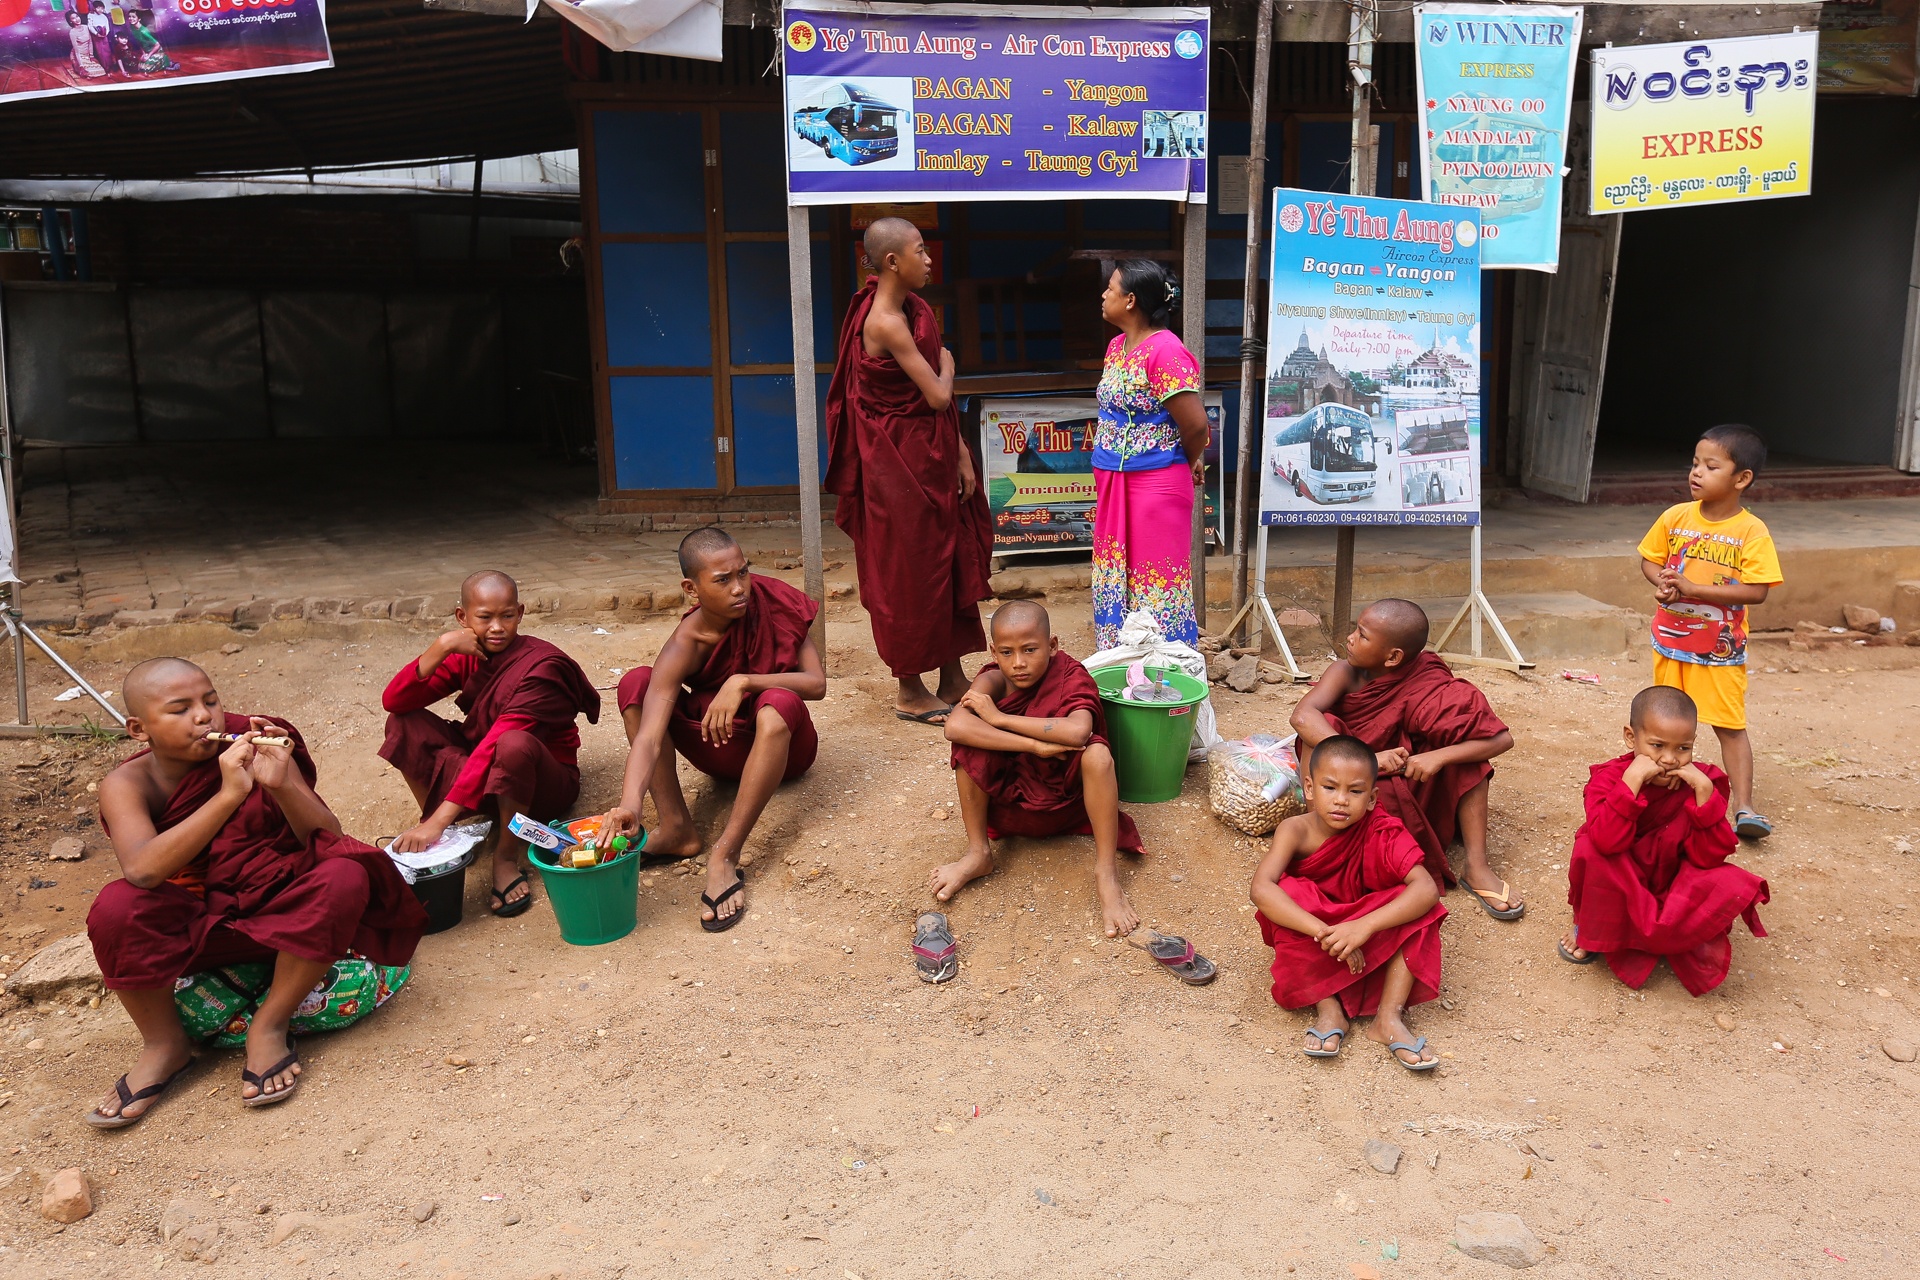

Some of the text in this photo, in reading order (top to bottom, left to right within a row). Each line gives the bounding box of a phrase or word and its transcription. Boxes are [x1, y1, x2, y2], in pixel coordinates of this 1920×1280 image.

[1455, 22, 1565, 47] WINNER
[861, 30, 909, 53] Thu
[914, 31, 976, 60] Aung
[1002, 34, 1038, 56] Air
[1043, 35, 1086, 57] Con
[1089, 35, 1171, 62] Express
[1460, 62, 1534, 78] EXPRESS
[914, 77, 1011, 100] BAGAN
[1065, 79, 1148, 103] Yangon
[1447, 98, 1545, 114] NYAUNG OO
[915, 114, 1012, 136] BAGAN
[1068, 114, 1138, 138] Kalaw
[1444, 130, 1536, 146] MANDALAY
[1641, 125, 1763, 160] EXPRESS
[917, 150, 989, 176] Innlay
[1025, 151, 1092, 176] Taung
[1097, 151, 1138, 176] Gyi
[1441, 162, 1554, 178] PYIN OO LWIN
[1440, 193, 1501, 207] HSIPAW
[1340, 204, 1388, 241] Thu
[1392, 208, 1455, 253] Aung
[1381, 245, 1475, 267] Aircon Express
[1302, 257, 1456, 284] Bagan Yangon
[1334, 282, 1424, 299] Bagan Kalaw
[1277, 303, 1326, 320] Nyaung
[1417, 310, 1454, 325] Taung
[1456, 312, 1475, 326] Gyi
[1332, 326, 1413, 341] Departure time
[1395, 346, 1414, 357] pm
[1034, 421, 1073, 453] Thu
[1271, 513, 1467, 524] Ph:061-60230, 09-49218470, 09-402514104
[994, 531, 1074, 545] Bagan-Nyaung Oo
